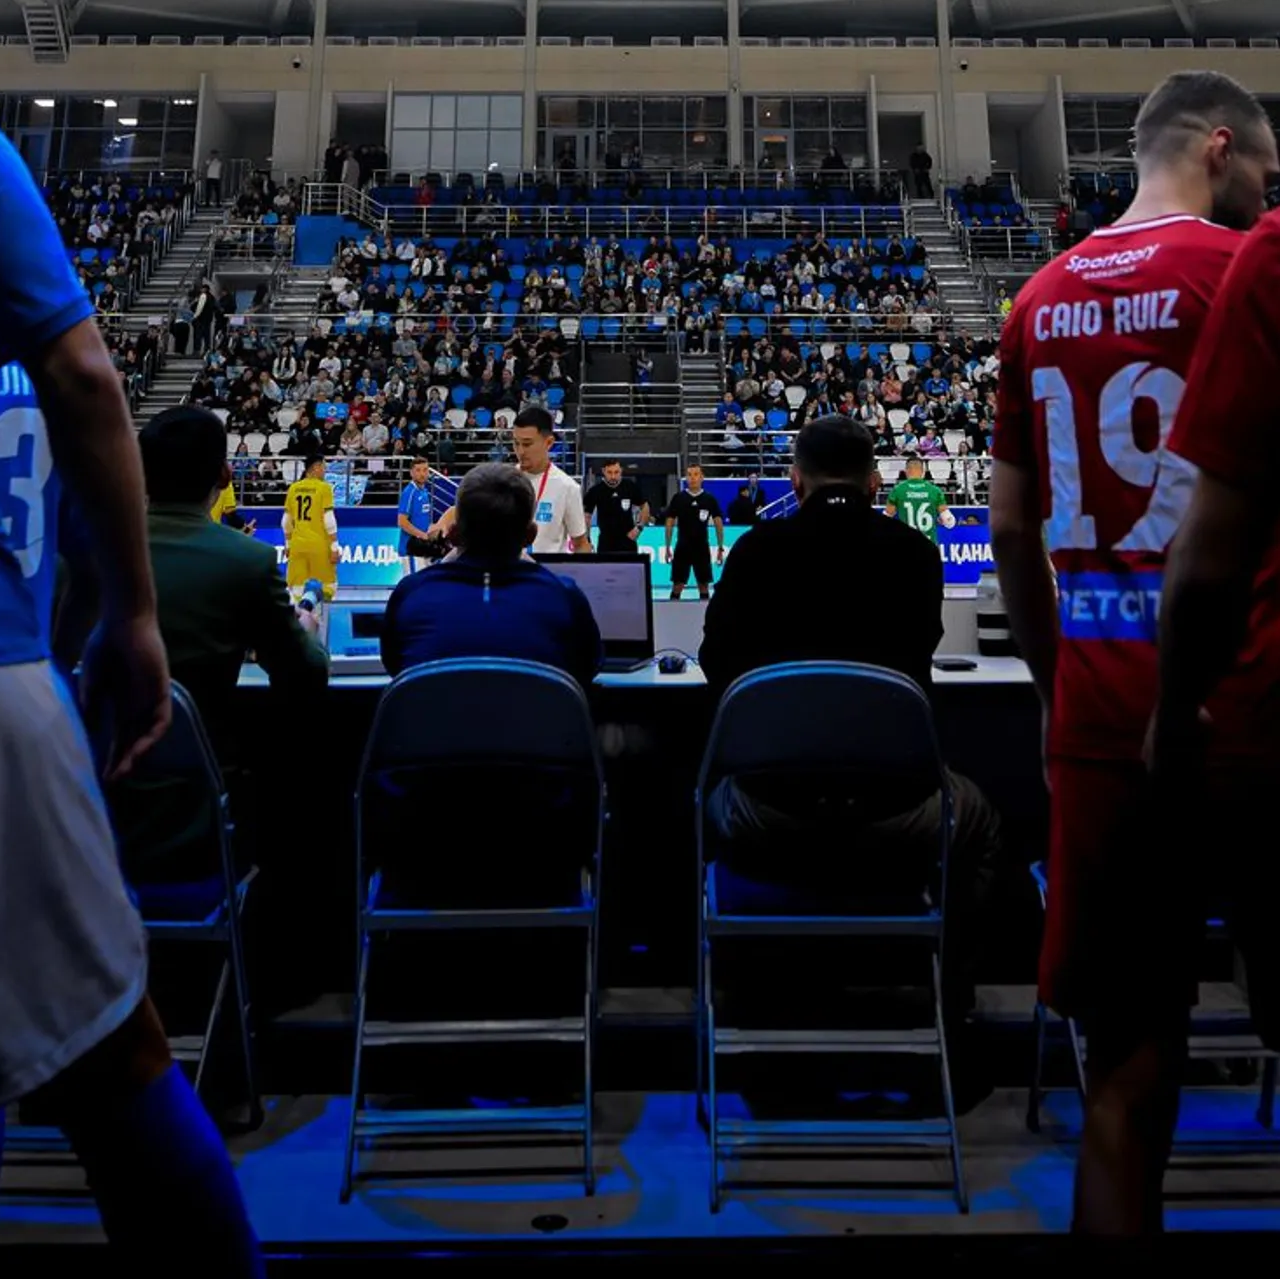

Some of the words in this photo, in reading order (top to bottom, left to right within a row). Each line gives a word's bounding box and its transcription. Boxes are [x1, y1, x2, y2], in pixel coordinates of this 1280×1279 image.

[1034, 300, 1103, 342] CAIO
[1112, 288, 1181, 335] RUIZ
[1031, 360, 1200, 553] 19
[296, 495, 312, 521] 12
[903, 502, 933, 531] 16
